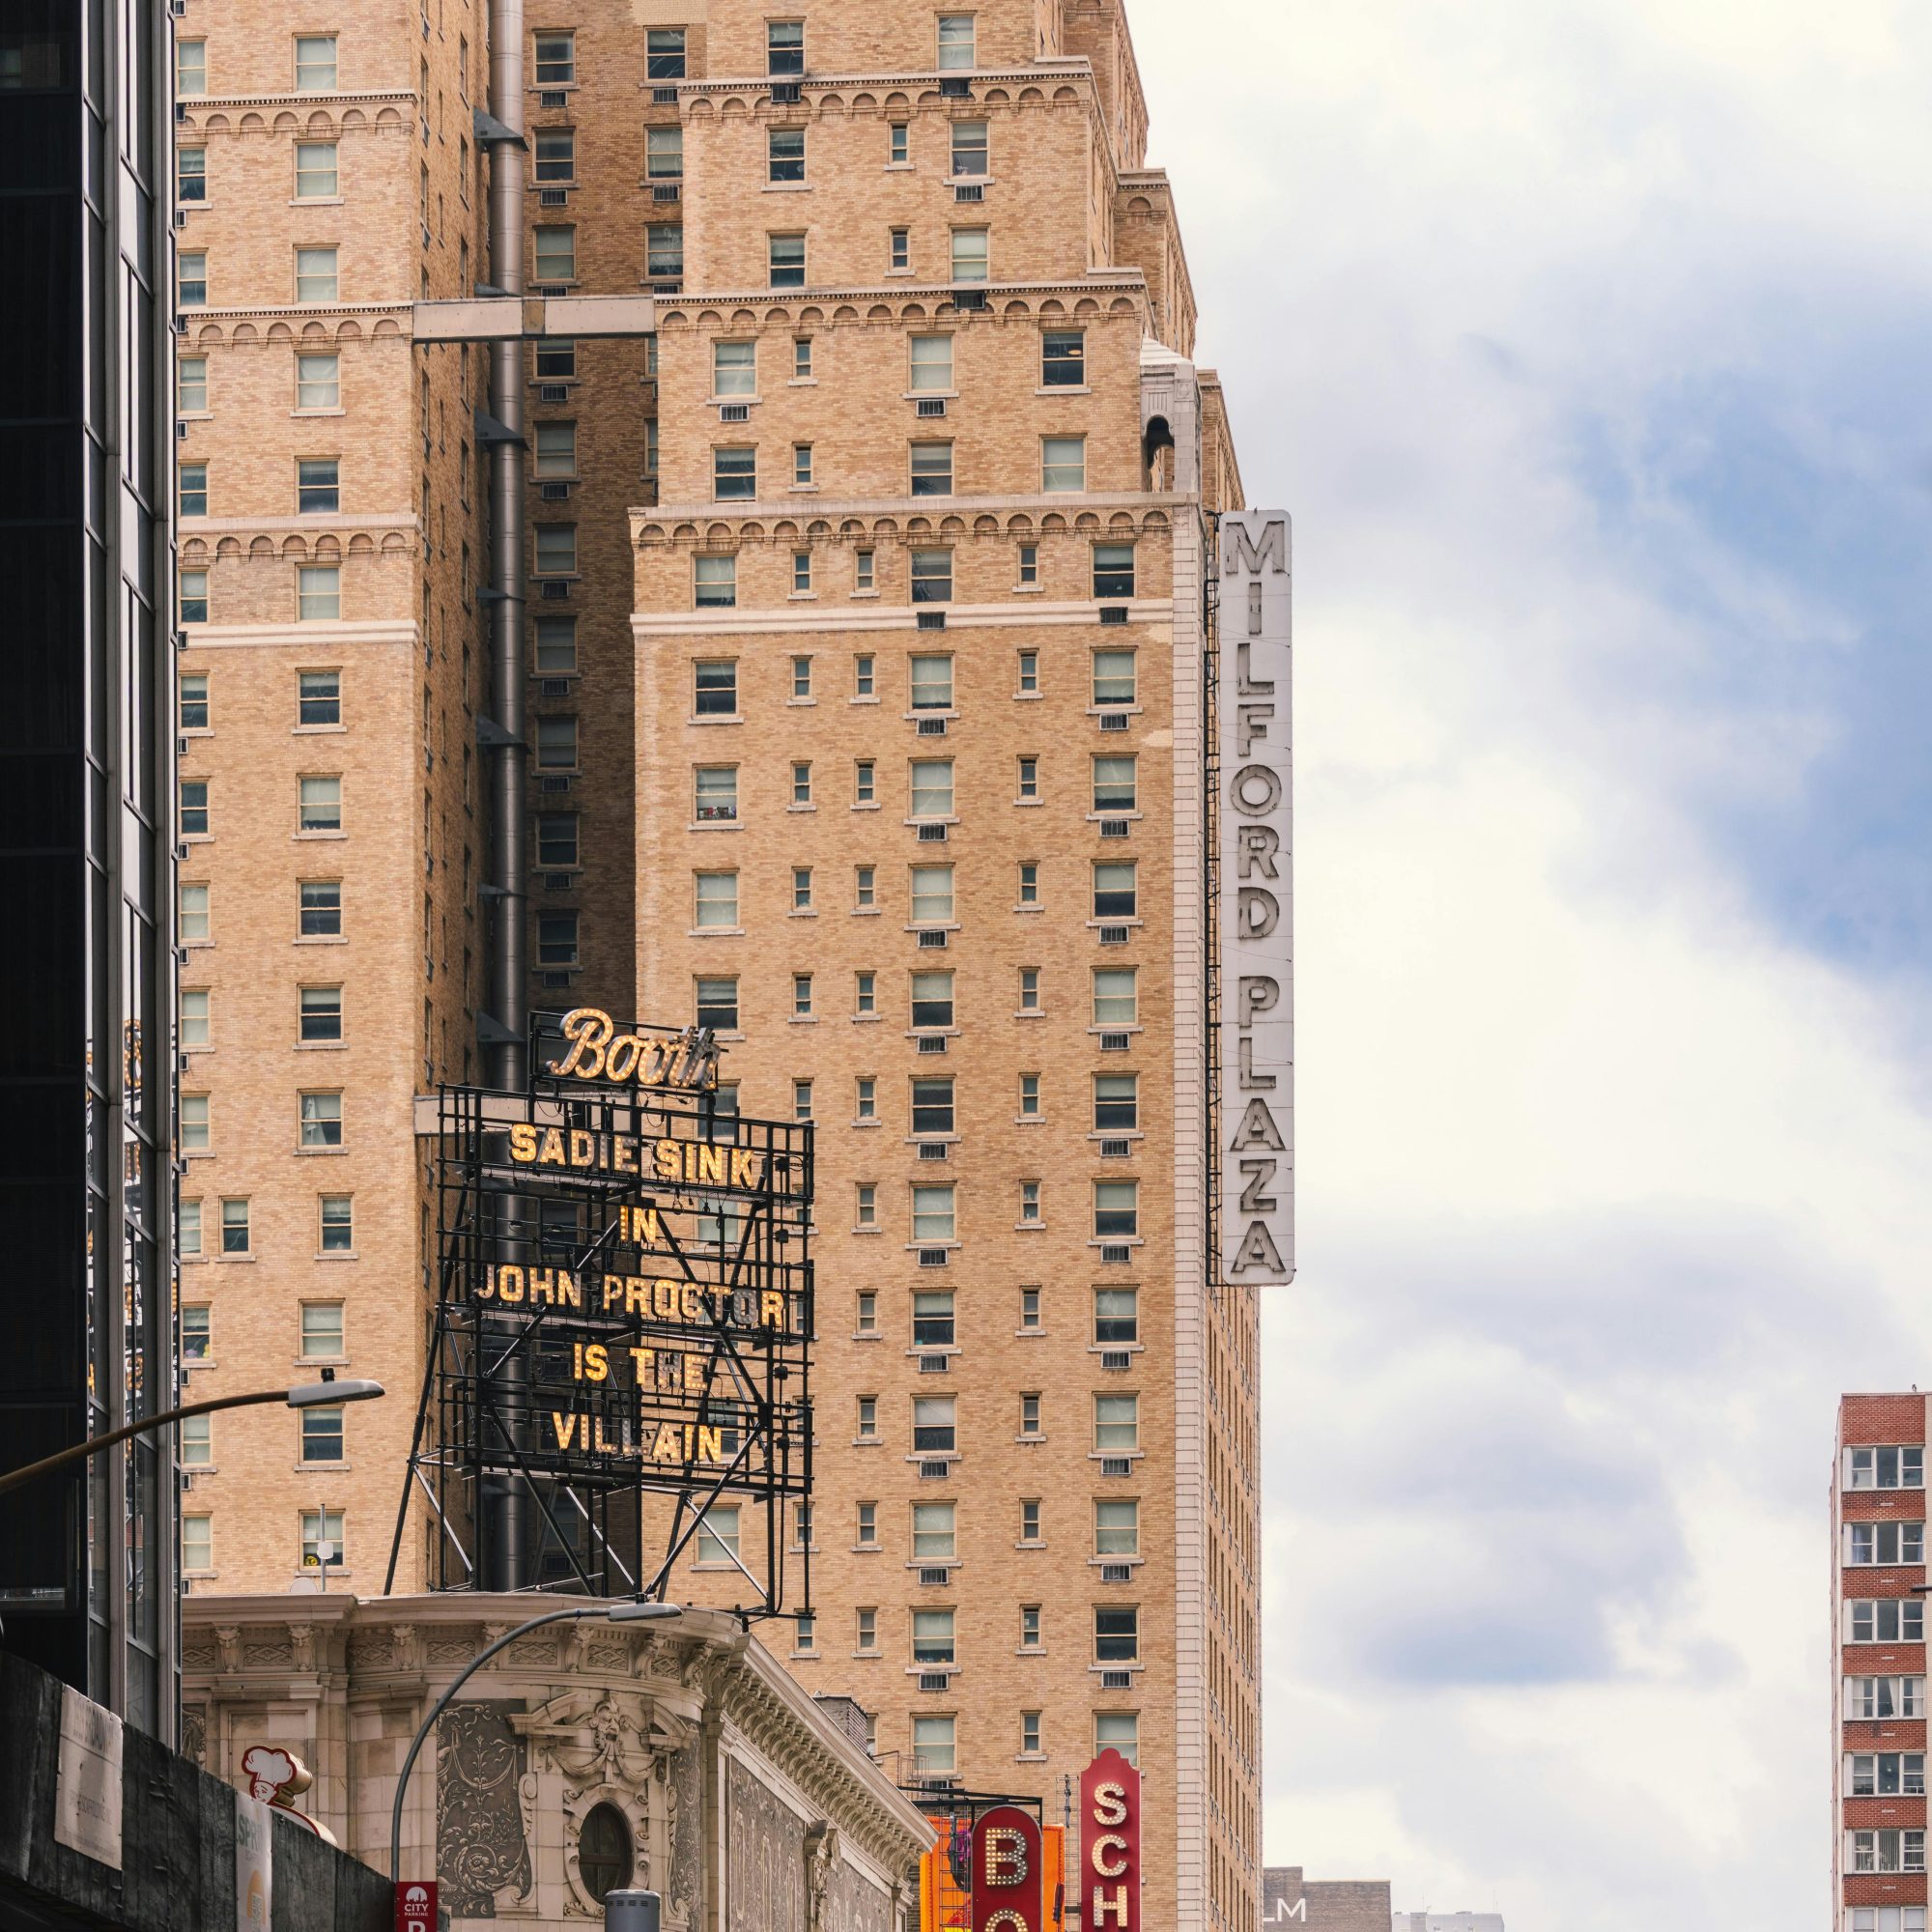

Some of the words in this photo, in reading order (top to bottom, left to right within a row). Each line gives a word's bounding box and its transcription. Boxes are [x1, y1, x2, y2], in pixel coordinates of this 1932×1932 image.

[1225, 521, 1285, 939] MILFORD
[547, 1008, 721, 1091] Booth
[511, 1123, 639, 1173] SADIE
[654, 1139, 755, 1187] SINK
[1230, 976, 1286, 1273] PLAZA
[620, 1206, 656, 1243] IN
[476, 1264, 582, 1306] JOHN
[603, 1274, 784, 1326] PROCTOR
[574, 1344, 608, 1381] IS
[630, 1348, 708, 1391] THE
[553, 1412, 722, 1463] VILLAIN
[1091, 1782, 1127, 1927] SCH
[404, 1903, 429, 1912] CITY
